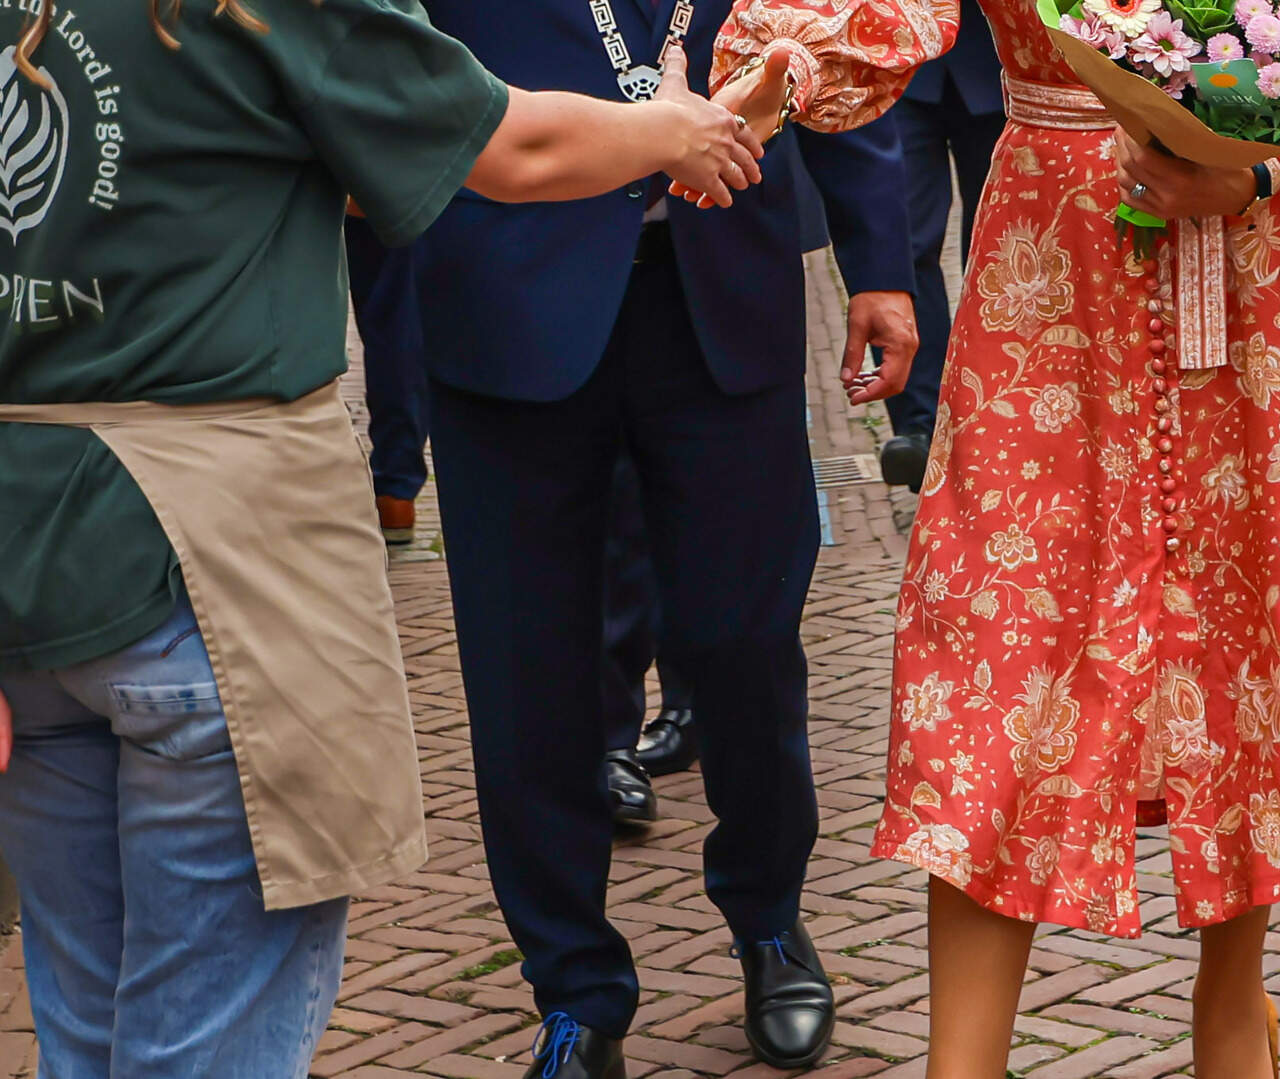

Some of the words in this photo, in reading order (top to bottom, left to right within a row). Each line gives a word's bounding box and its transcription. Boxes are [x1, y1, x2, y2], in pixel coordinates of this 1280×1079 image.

[56, 10, 112, 83] Lord
[94, 85, 121, 116] is
[1211, 94, 1261, 107] PLUK
[88, 122, 124, 211] good!
